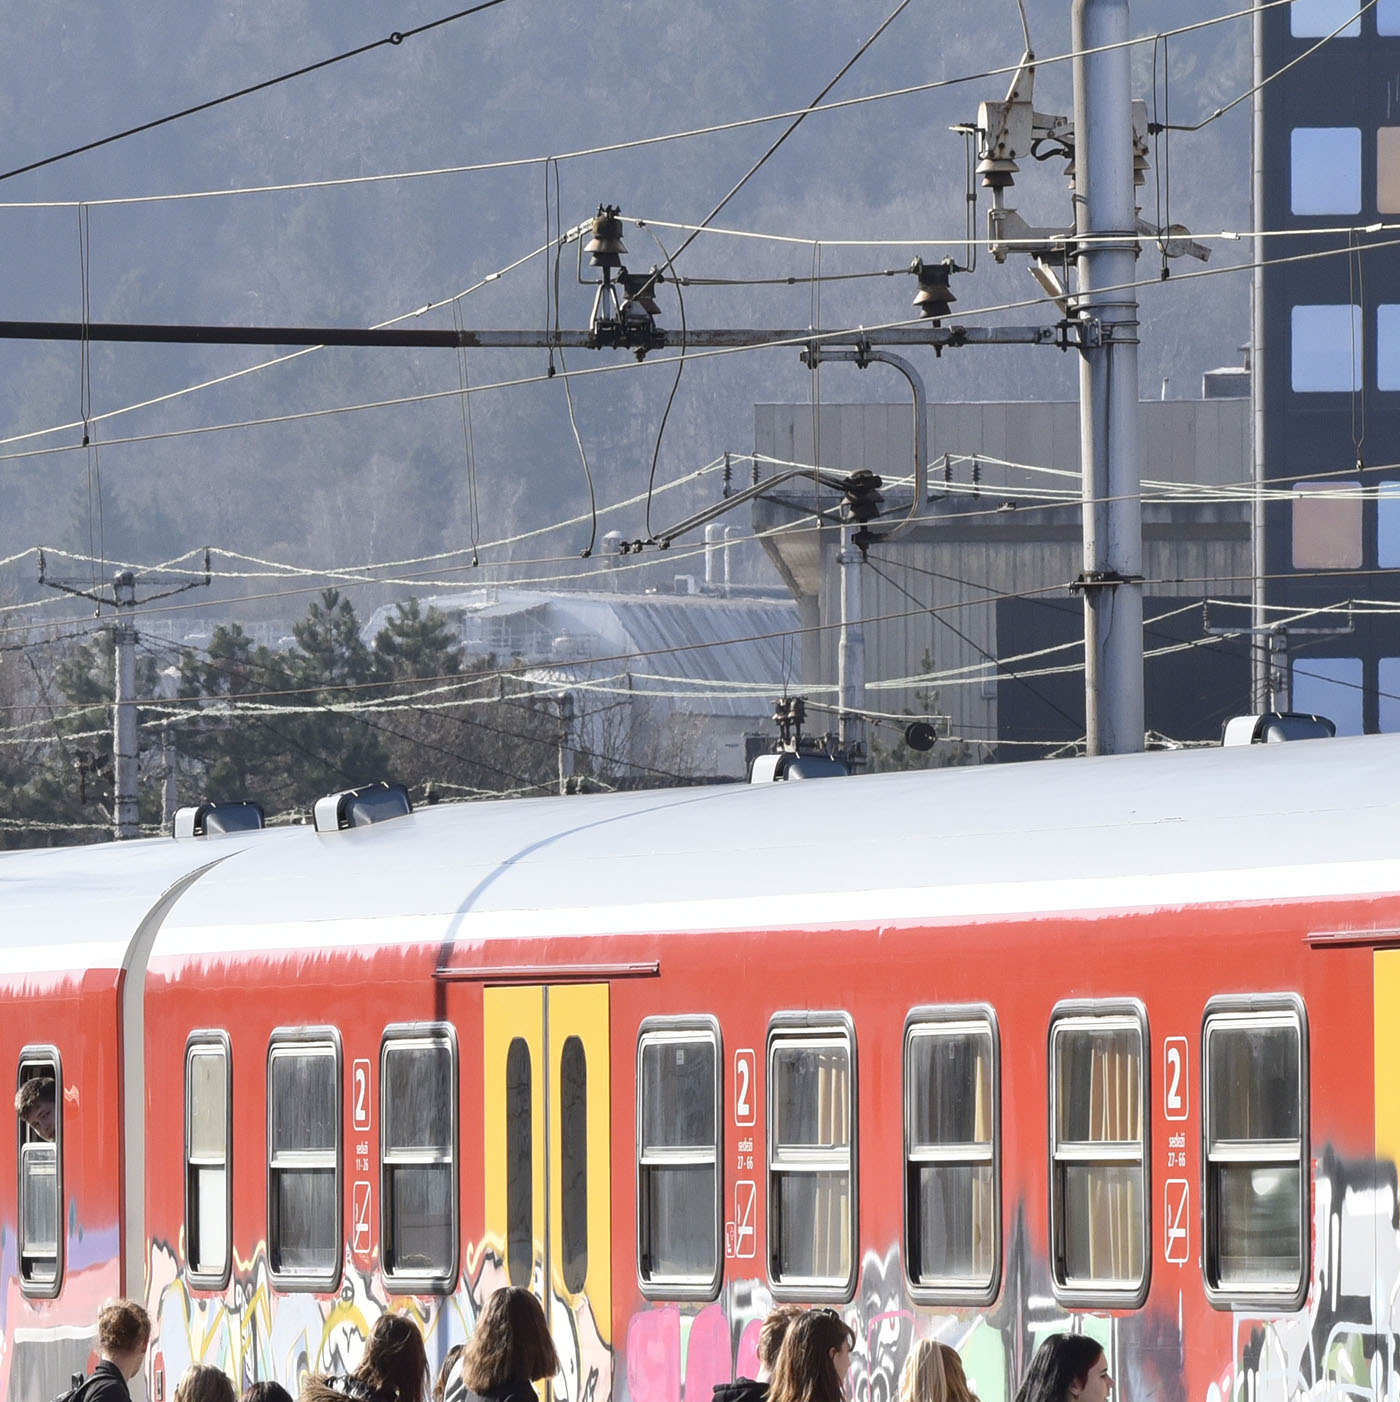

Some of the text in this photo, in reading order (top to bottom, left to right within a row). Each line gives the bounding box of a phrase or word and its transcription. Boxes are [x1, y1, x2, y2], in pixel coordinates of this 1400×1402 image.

[355, 1068, 366, 1121] 2
[737, 1058, 750, 1116] 2
[1167, 1047, 1182, 1109] 2
